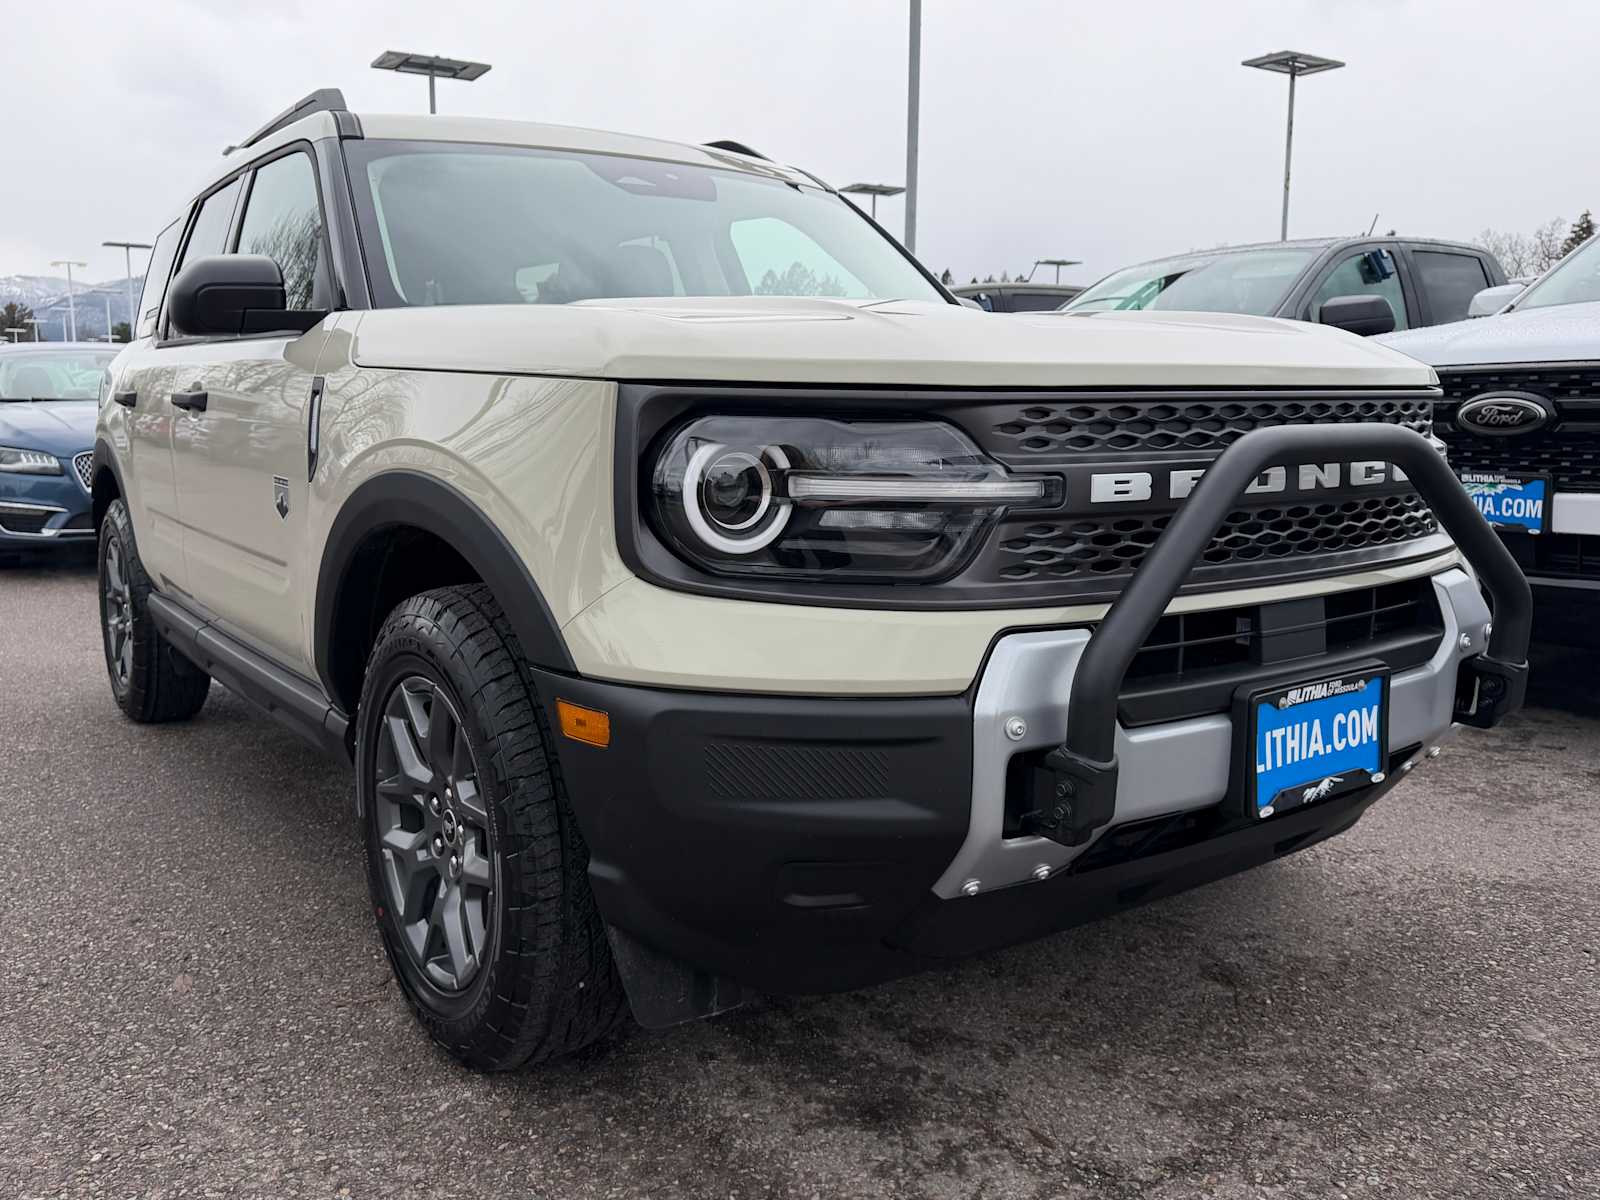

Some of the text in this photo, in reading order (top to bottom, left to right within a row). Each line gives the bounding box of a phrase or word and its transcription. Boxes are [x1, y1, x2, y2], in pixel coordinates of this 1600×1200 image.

[1476, 404, 1524, 425] Ford
[1091, 461, 1409, 502] BRONC
[1473, 496, 1543, 519] IA.COM
[1295, 683, 1328, 704] LITHIA
